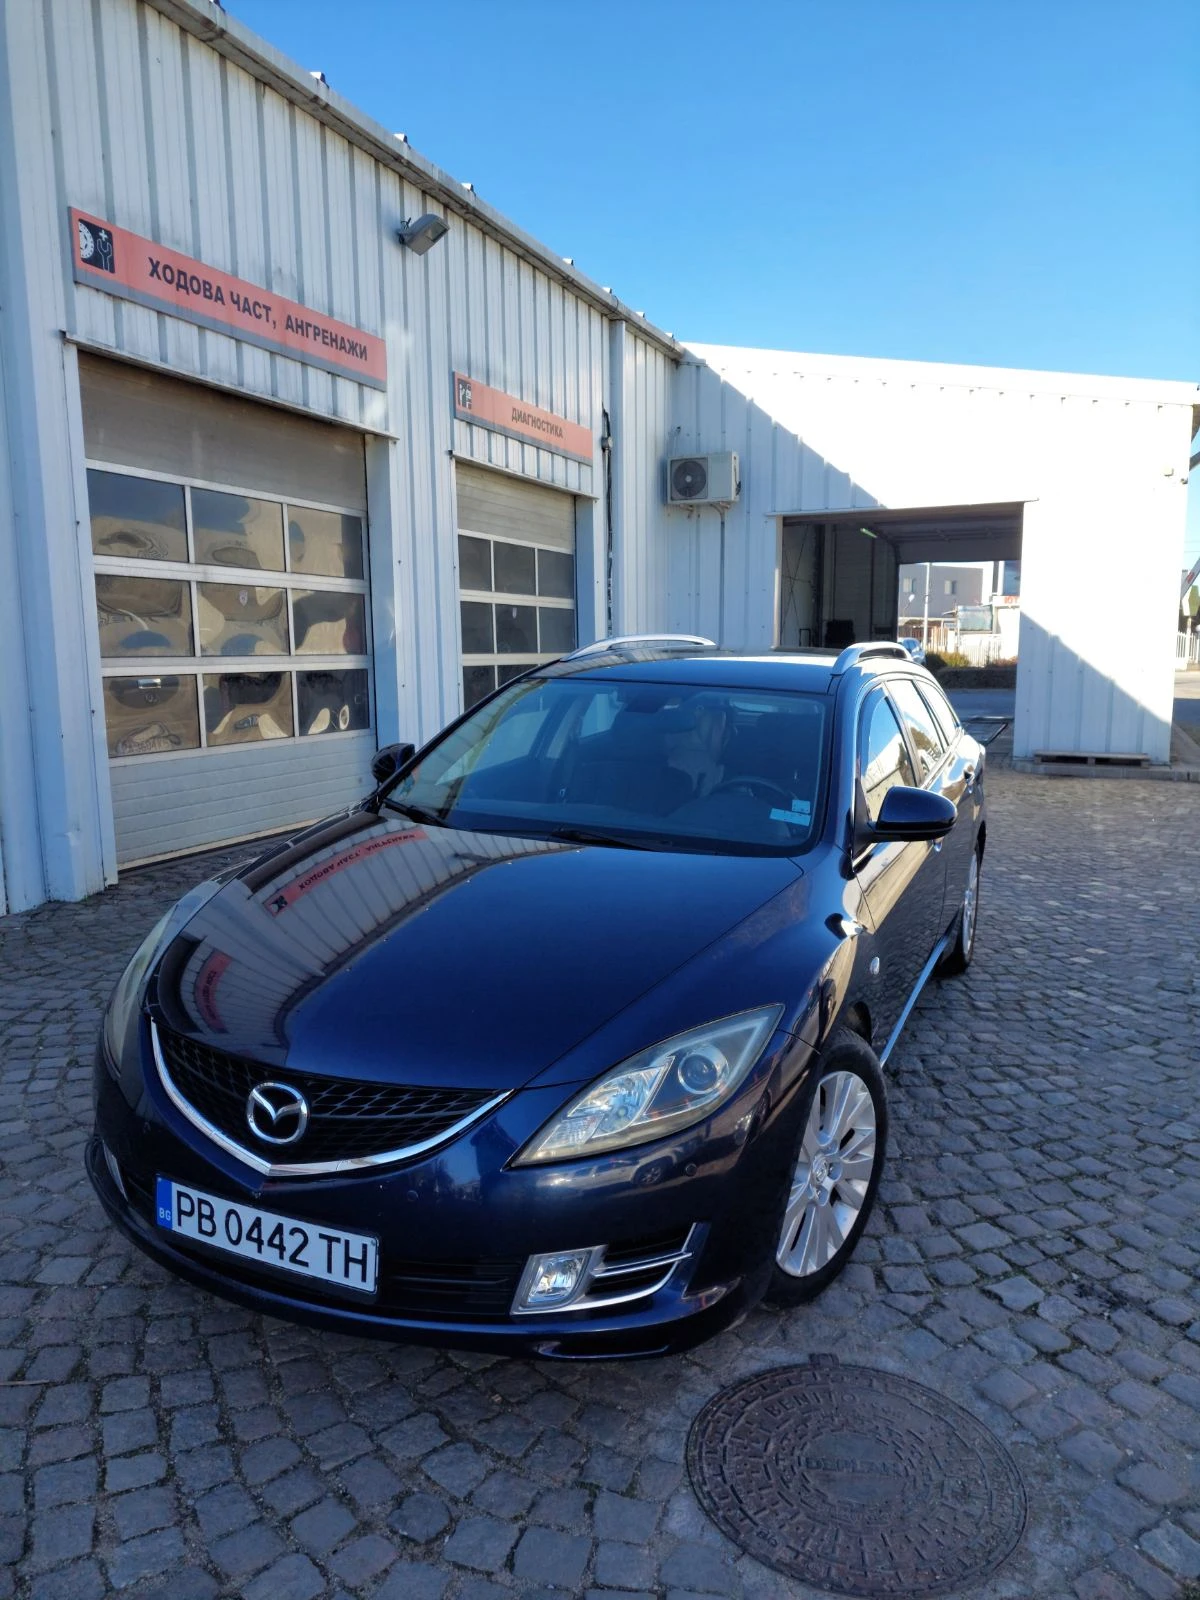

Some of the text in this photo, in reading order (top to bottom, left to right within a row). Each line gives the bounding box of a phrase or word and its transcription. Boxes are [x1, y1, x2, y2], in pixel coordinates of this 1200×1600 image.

[148, 257, 368, 361] ХОДОВА ЧАСТ, АНГРЕНАЖИ
[511, 407, 563, 438] ДИАГНОСТИКА
[158, 1207, 171, 1221] BG
[176, 1190, 368, 1283] PB 0442 TH
